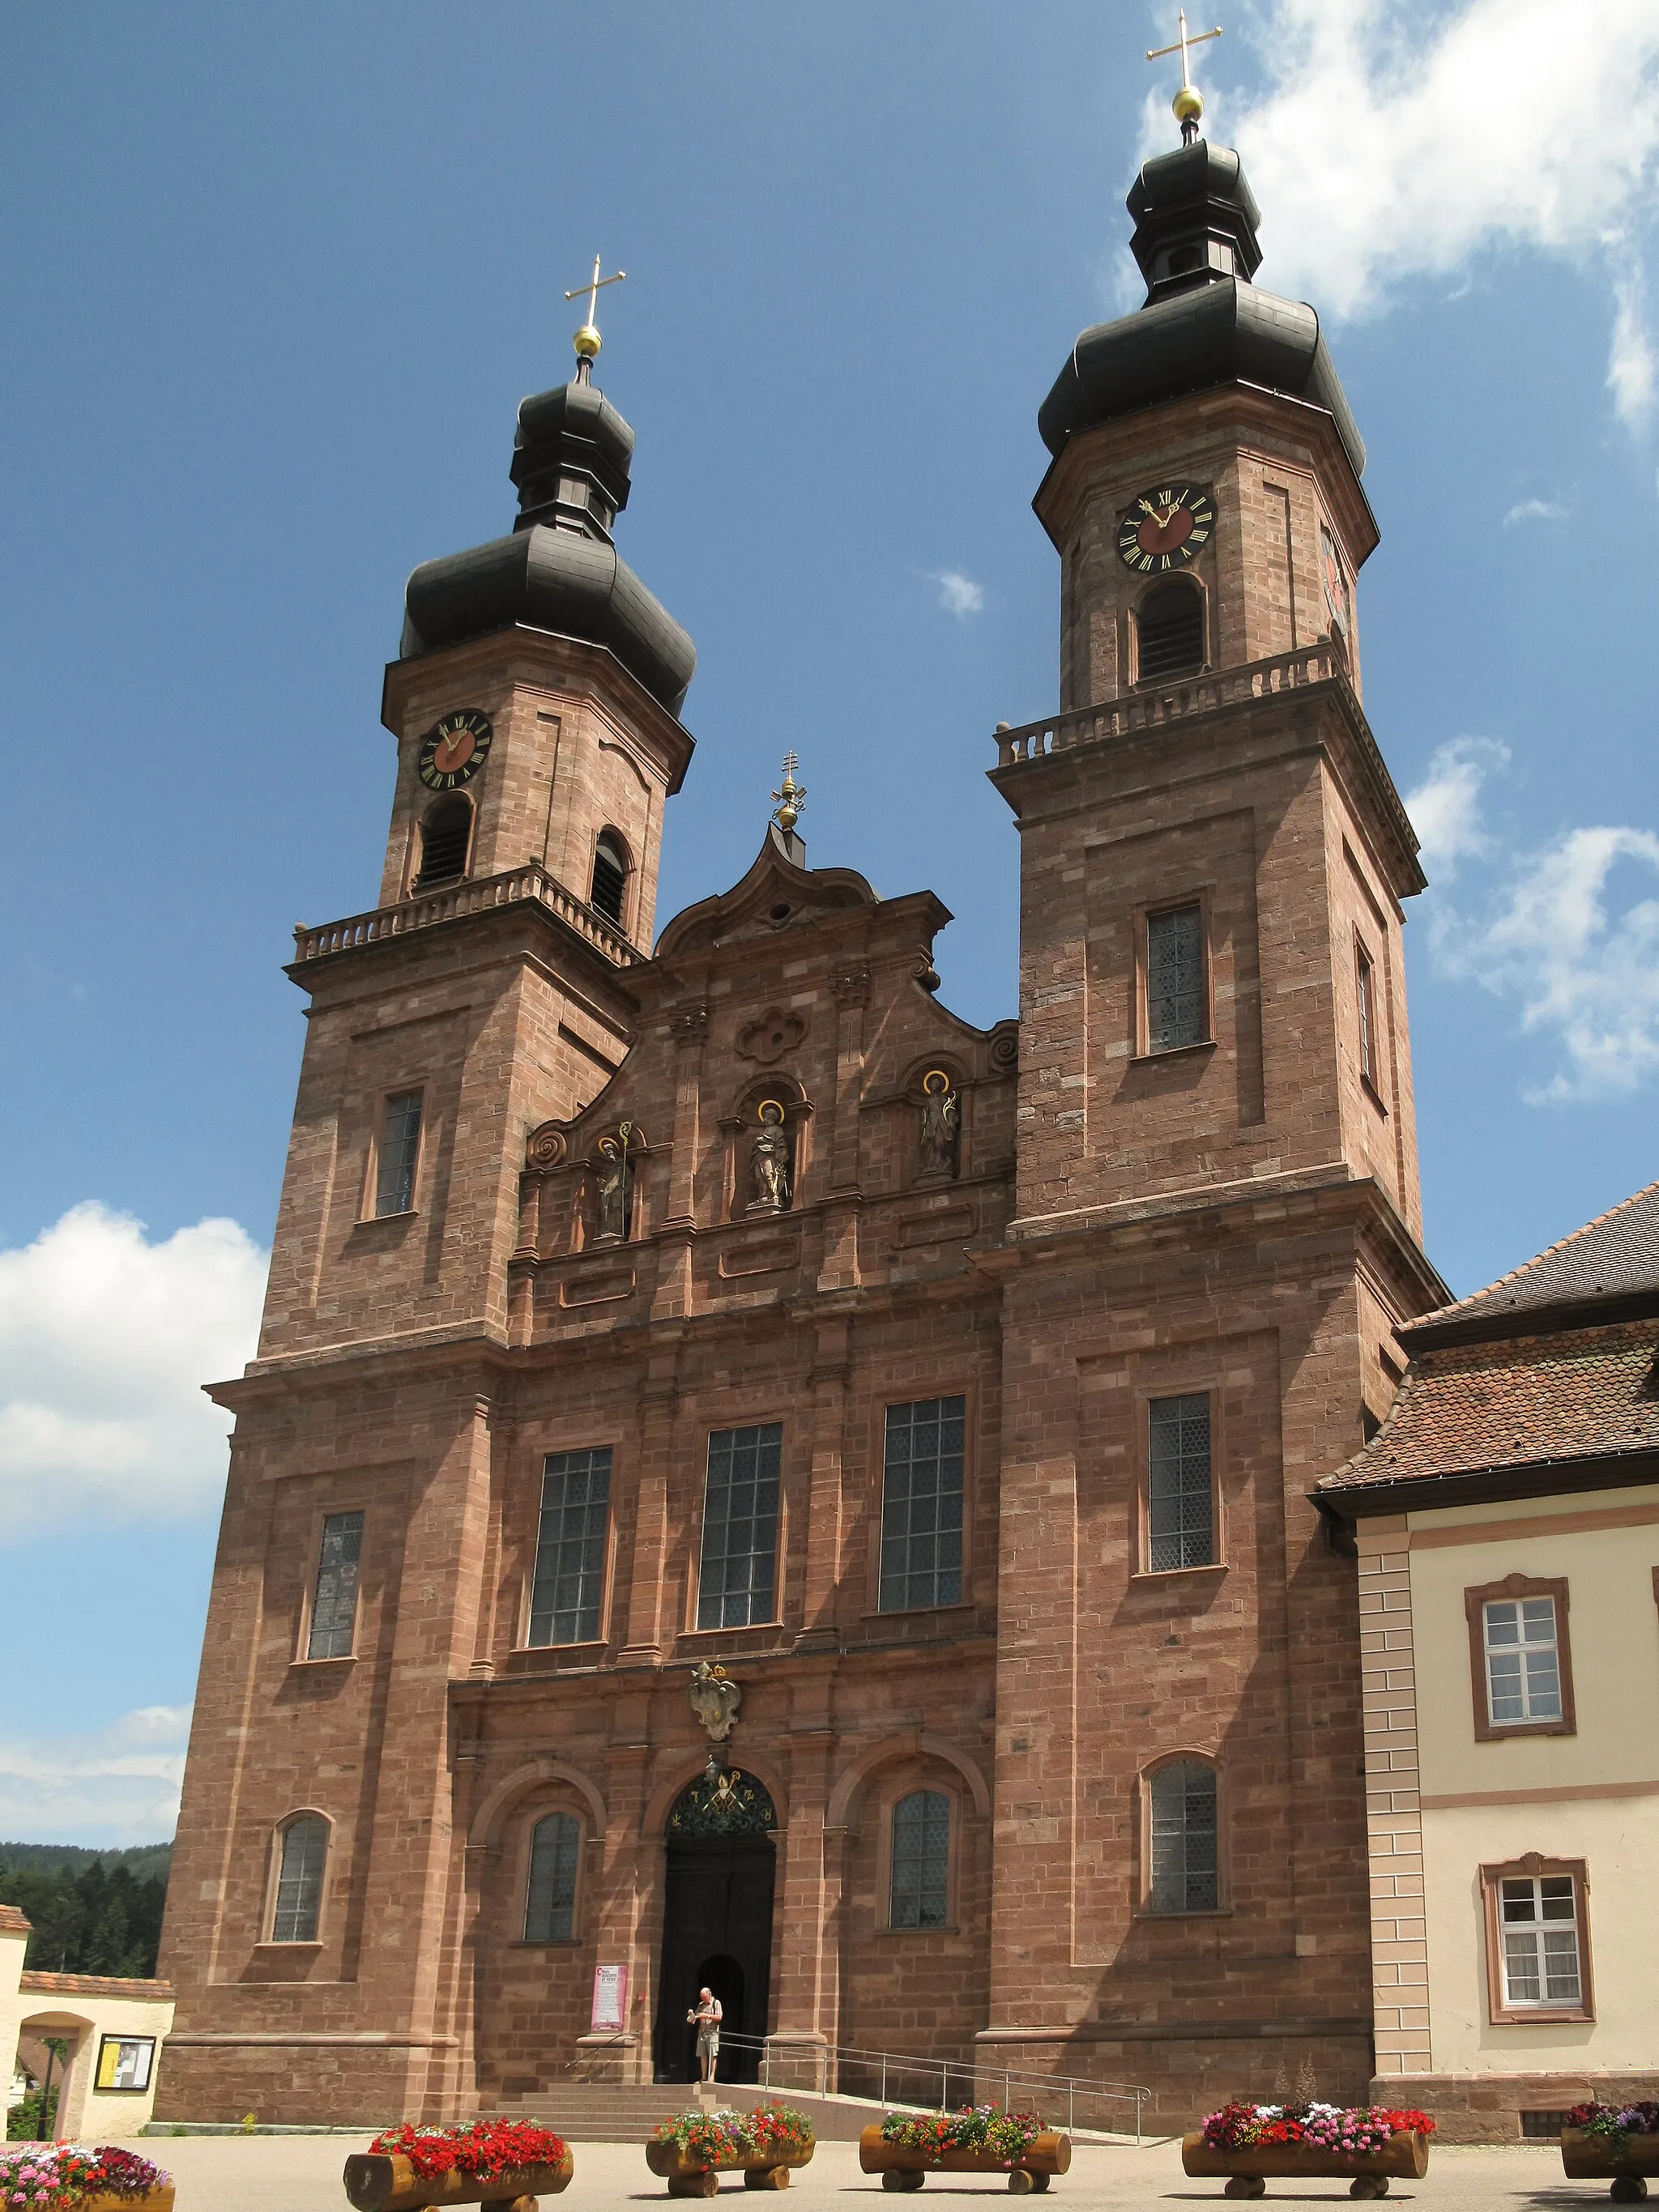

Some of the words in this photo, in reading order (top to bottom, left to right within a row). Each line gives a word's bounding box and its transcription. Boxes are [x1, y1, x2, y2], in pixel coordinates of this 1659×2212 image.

[1158, 489, 1171, 507] XII
[1179, 489, 1189, 504] I
[1190, 497, 1207, 511] II
[1124, 518, 1142, 528] X
[1195, 511, 1213, 524] III
[1120, 534, 1137, 548] IX
[1188, 529, 1209, 543] IIII
[1123, 545, 1142, 565] VIII
[1180, 546, 1192, 559] V
[1138, 554, 1154, 571] VII
[1161, 554, 1171, 570] VI
[427, 739, 439, 748] X
[463, 766, 471, 778] V
